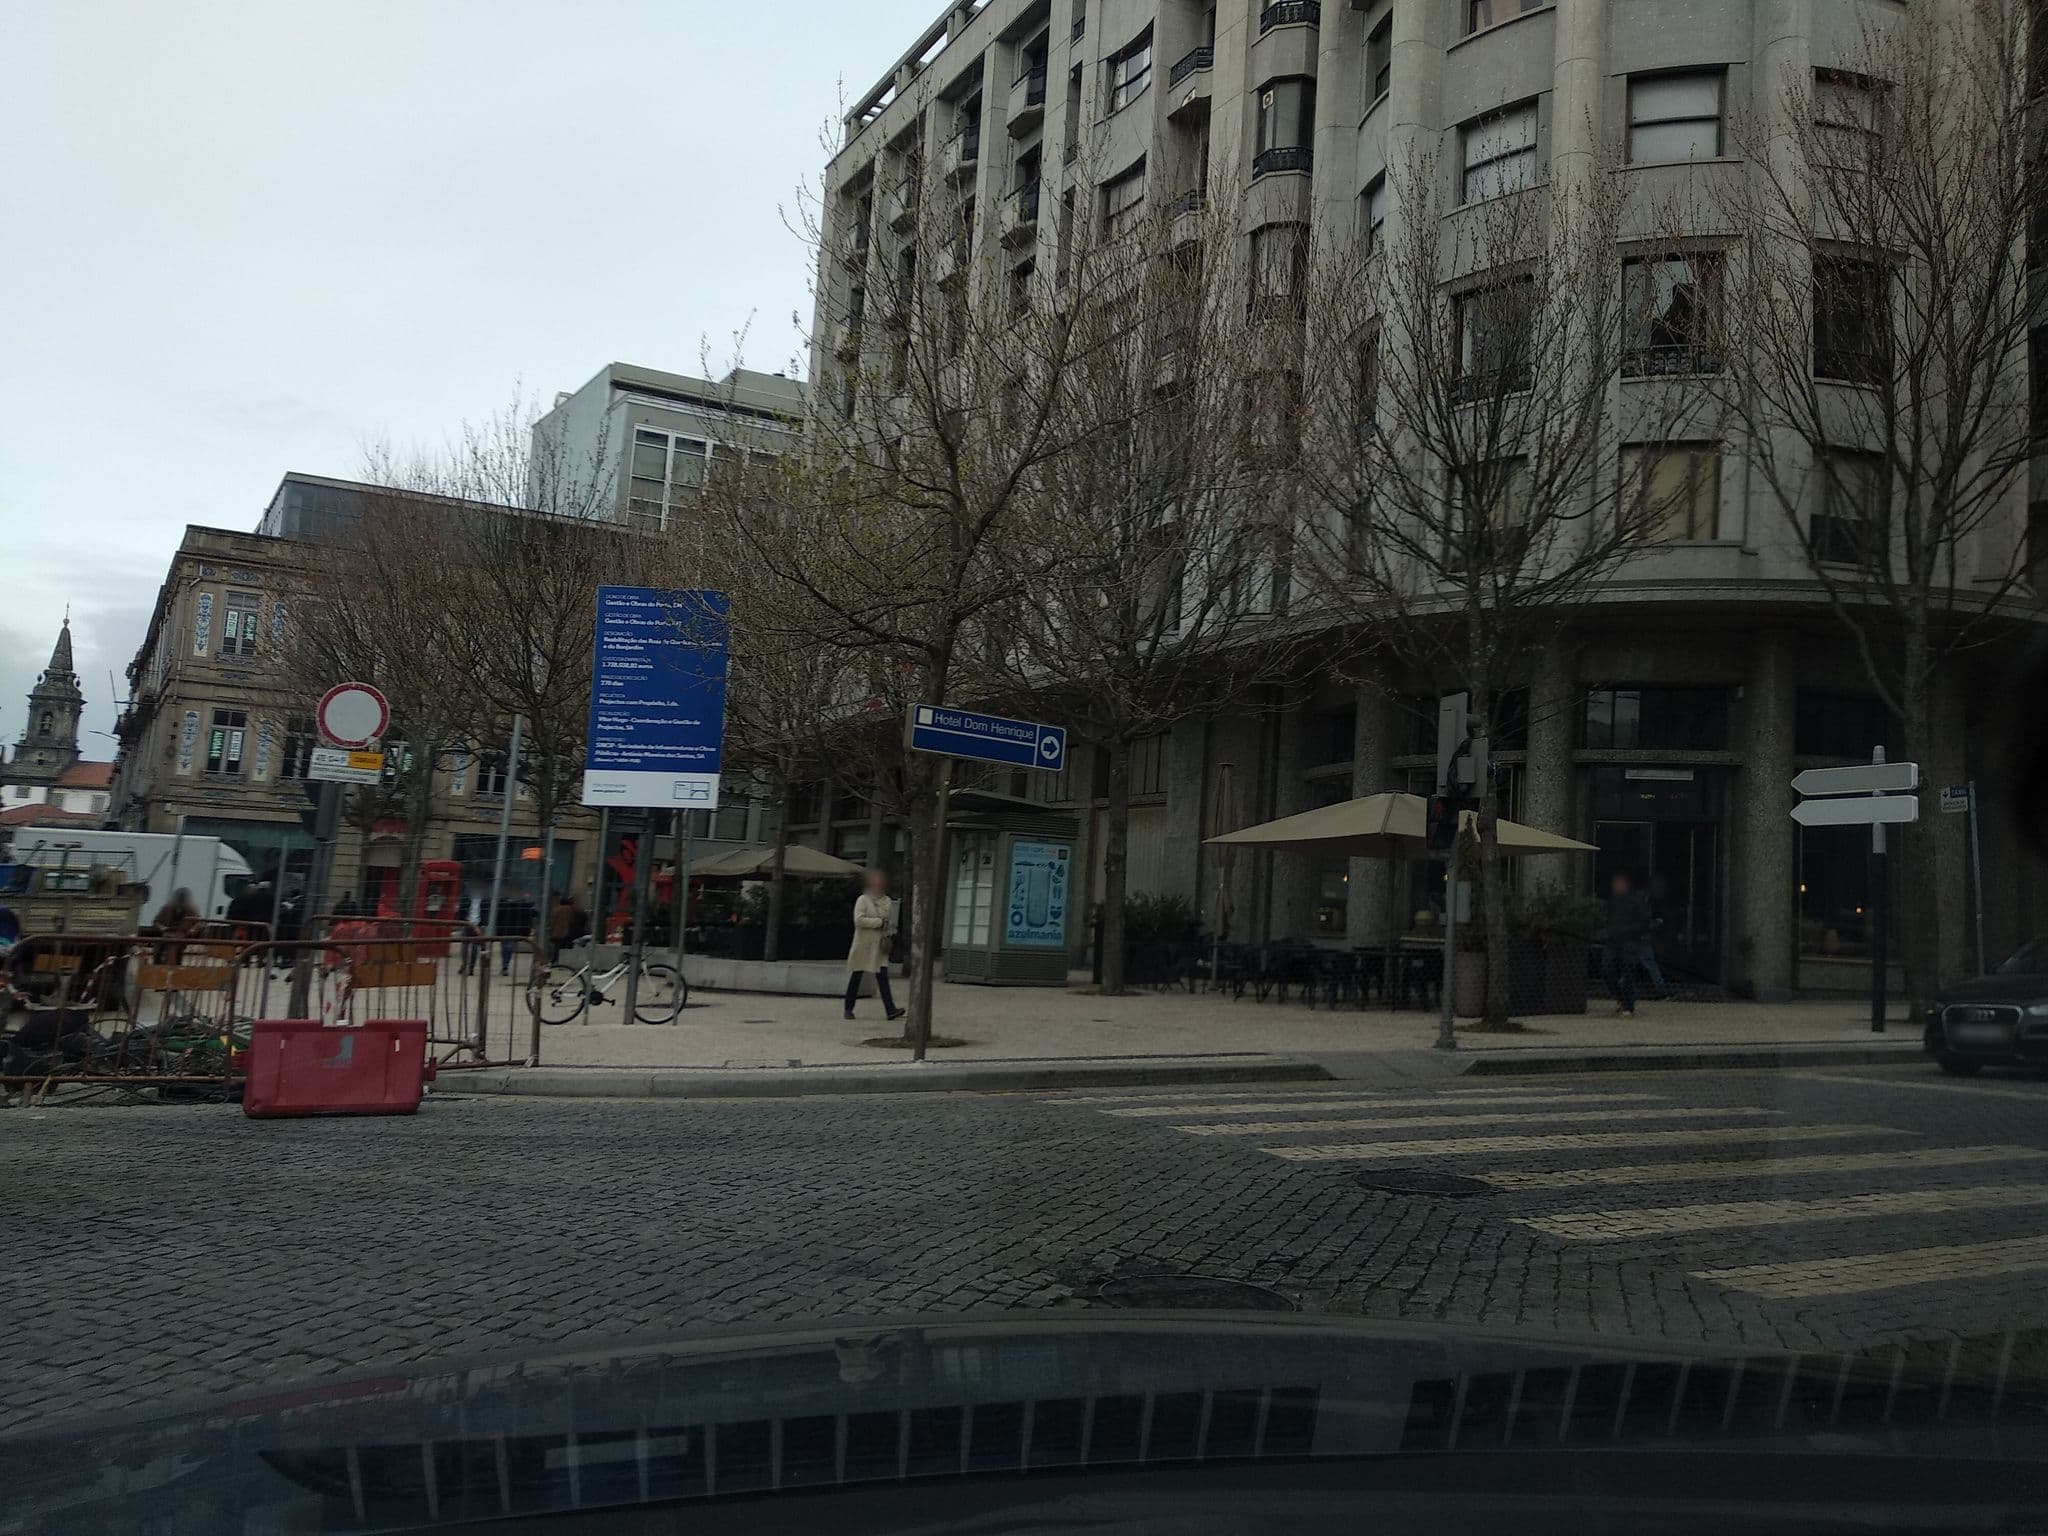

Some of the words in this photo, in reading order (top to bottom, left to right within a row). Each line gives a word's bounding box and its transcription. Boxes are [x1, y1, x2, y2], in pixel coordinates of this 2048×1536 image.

[934, 712, 961, 727] Hotel
[964, 718, 988, 732] Dom
[991, 724, 1035, 740] Henrique
